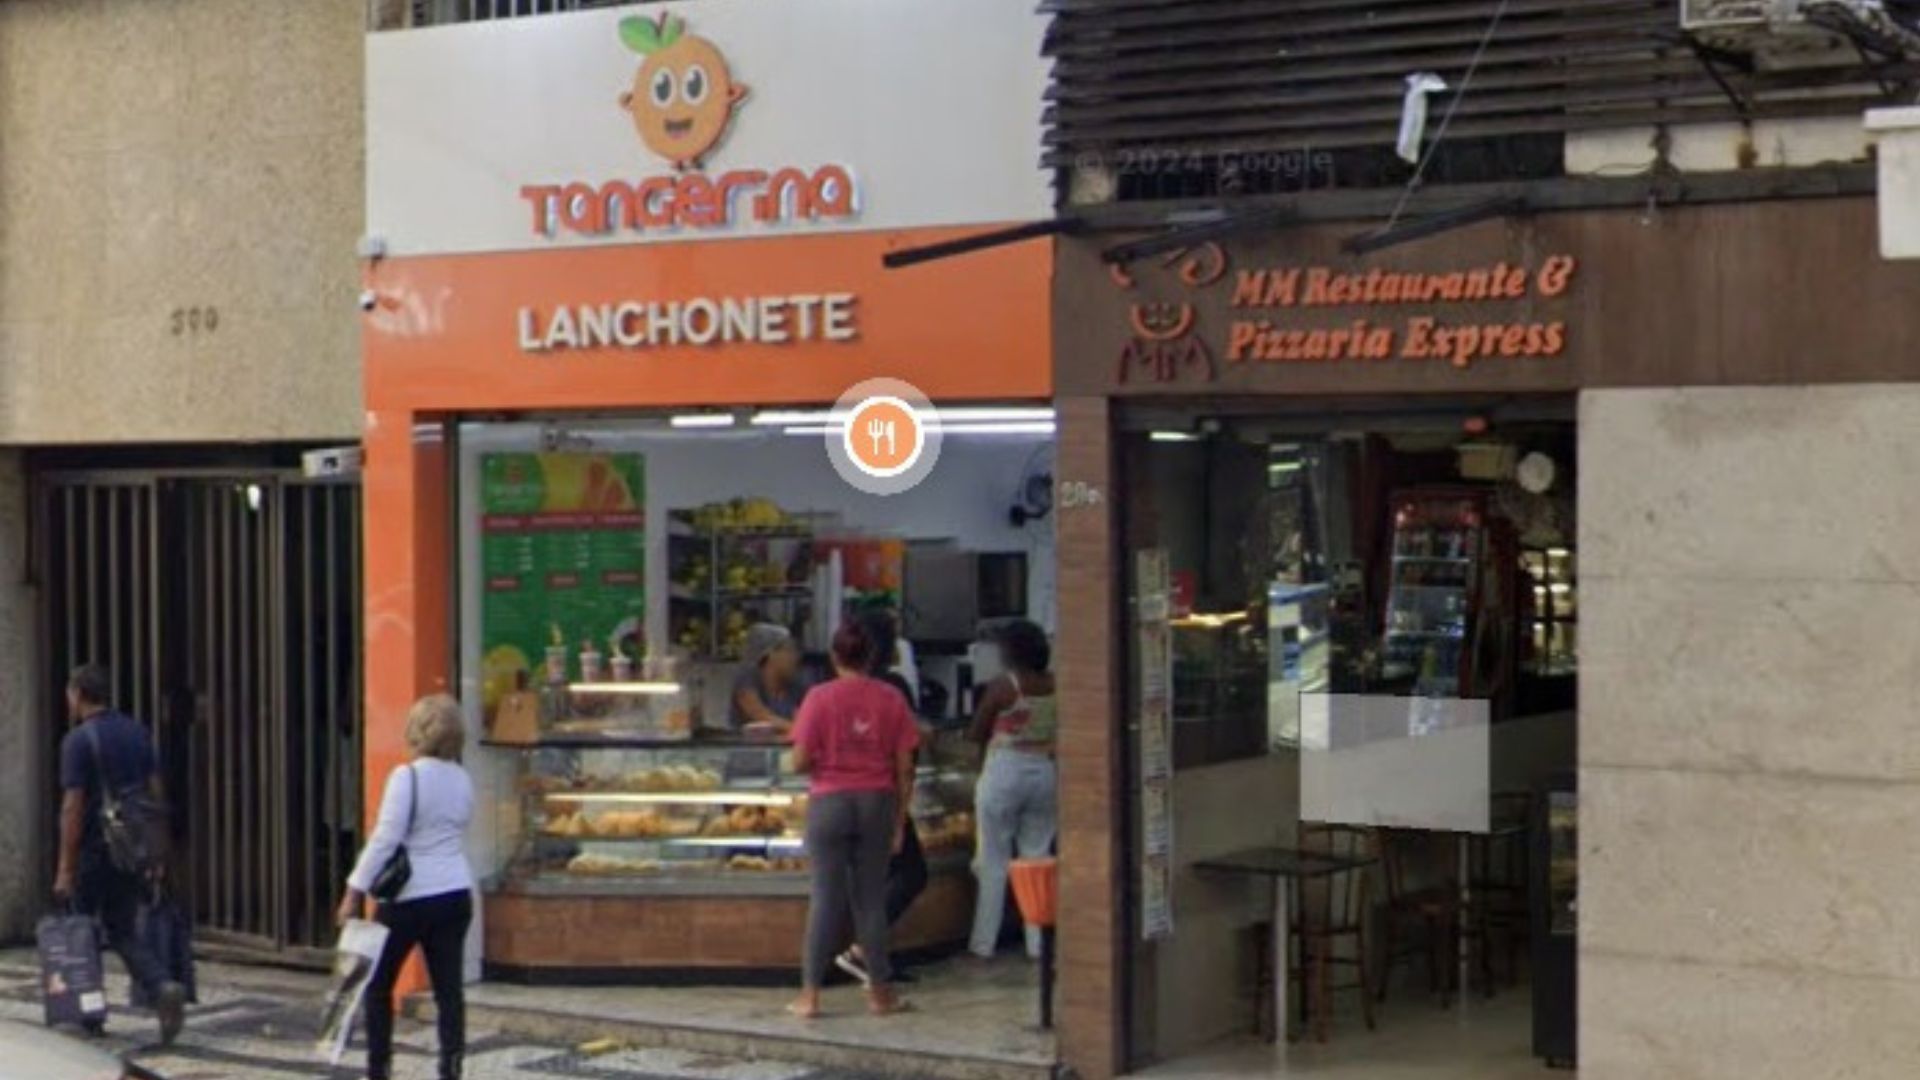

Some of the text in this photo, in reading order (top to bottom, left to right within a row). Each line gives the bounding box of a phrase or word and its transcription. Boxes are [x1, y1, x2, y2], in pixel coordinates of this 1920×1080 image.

[1302, 264, 1524, 304] Restaurante
[1537, 254, 1575, 296] &
[517, 294, 856, 351] LANCHONETE
[1226, 315, 1564, 366] Pizzaria Express
